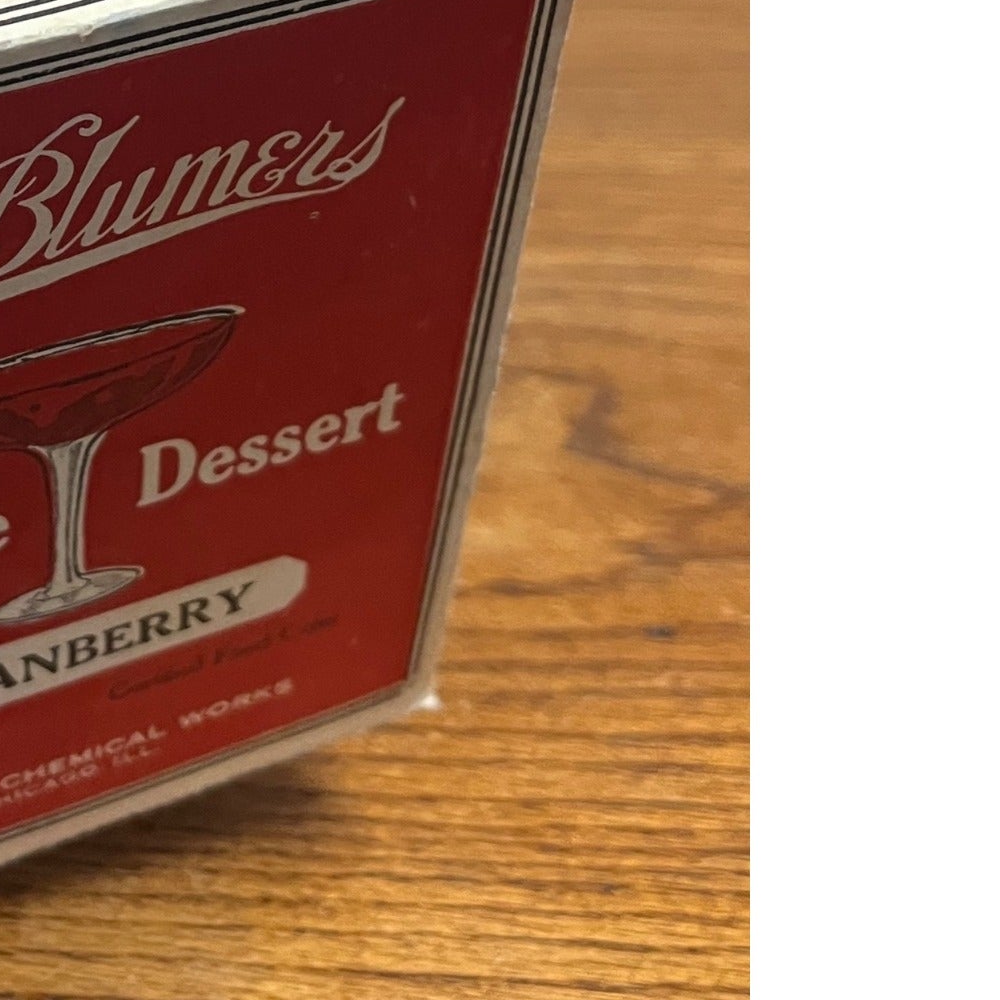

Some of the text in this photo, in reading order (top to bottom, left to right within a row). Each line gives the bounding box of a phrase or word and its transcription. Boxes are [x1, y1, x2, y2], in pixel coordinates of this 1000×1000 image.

[136, 382, 405, 508] Dessert
[0, 726, 168, 790] CHEMICAL
[178, 677, 295, 730] WORKS
